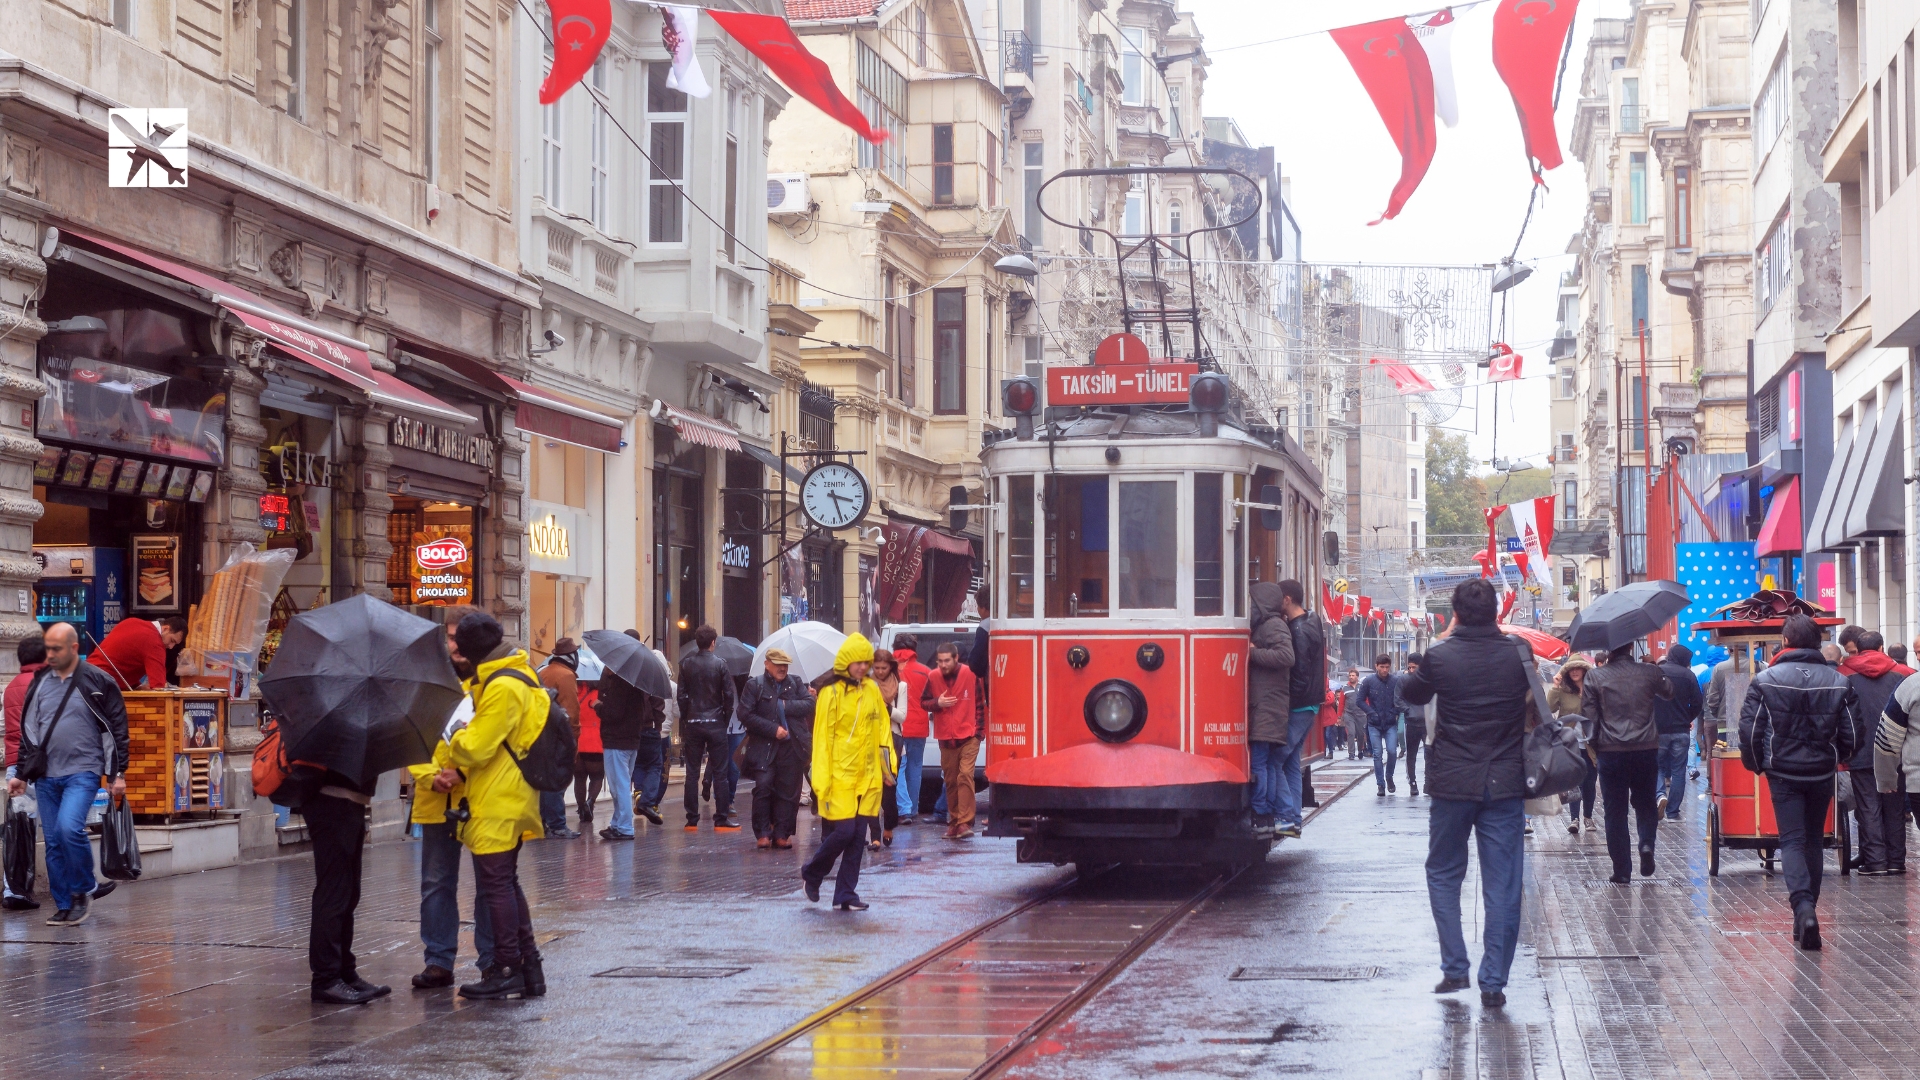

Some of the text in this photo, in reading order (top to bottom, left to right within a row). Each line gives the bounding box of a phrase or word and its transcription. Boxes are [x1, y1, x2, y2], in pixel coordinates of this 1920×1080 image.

[1117, 337, 1125, 362] 1
[47, 356, 73, 371] ANTAKY
[1061, 370, 1117, 395] TAKSİM
[1135, 369, 1188, 393] TÜNEL
[883, 531, 898, 583] BOOKS
[421, 573, 463, 584] BEYOĞLU
[416, 586, 467, 599] ÇİKOLATASI
[1821, 588, 1836, 598] SNE
[103, 606, 121, 623] ŞOK
[1518, 607, 1553, 619] SHKE
[103, 622, 119, 633] SOĞ
[994, 654, 1008, 677] 47
[1222, 653, 1239, 676] 47
[1006, 723, 1026, 732] YASAK
[1204, 736, 1213, 745] VE
